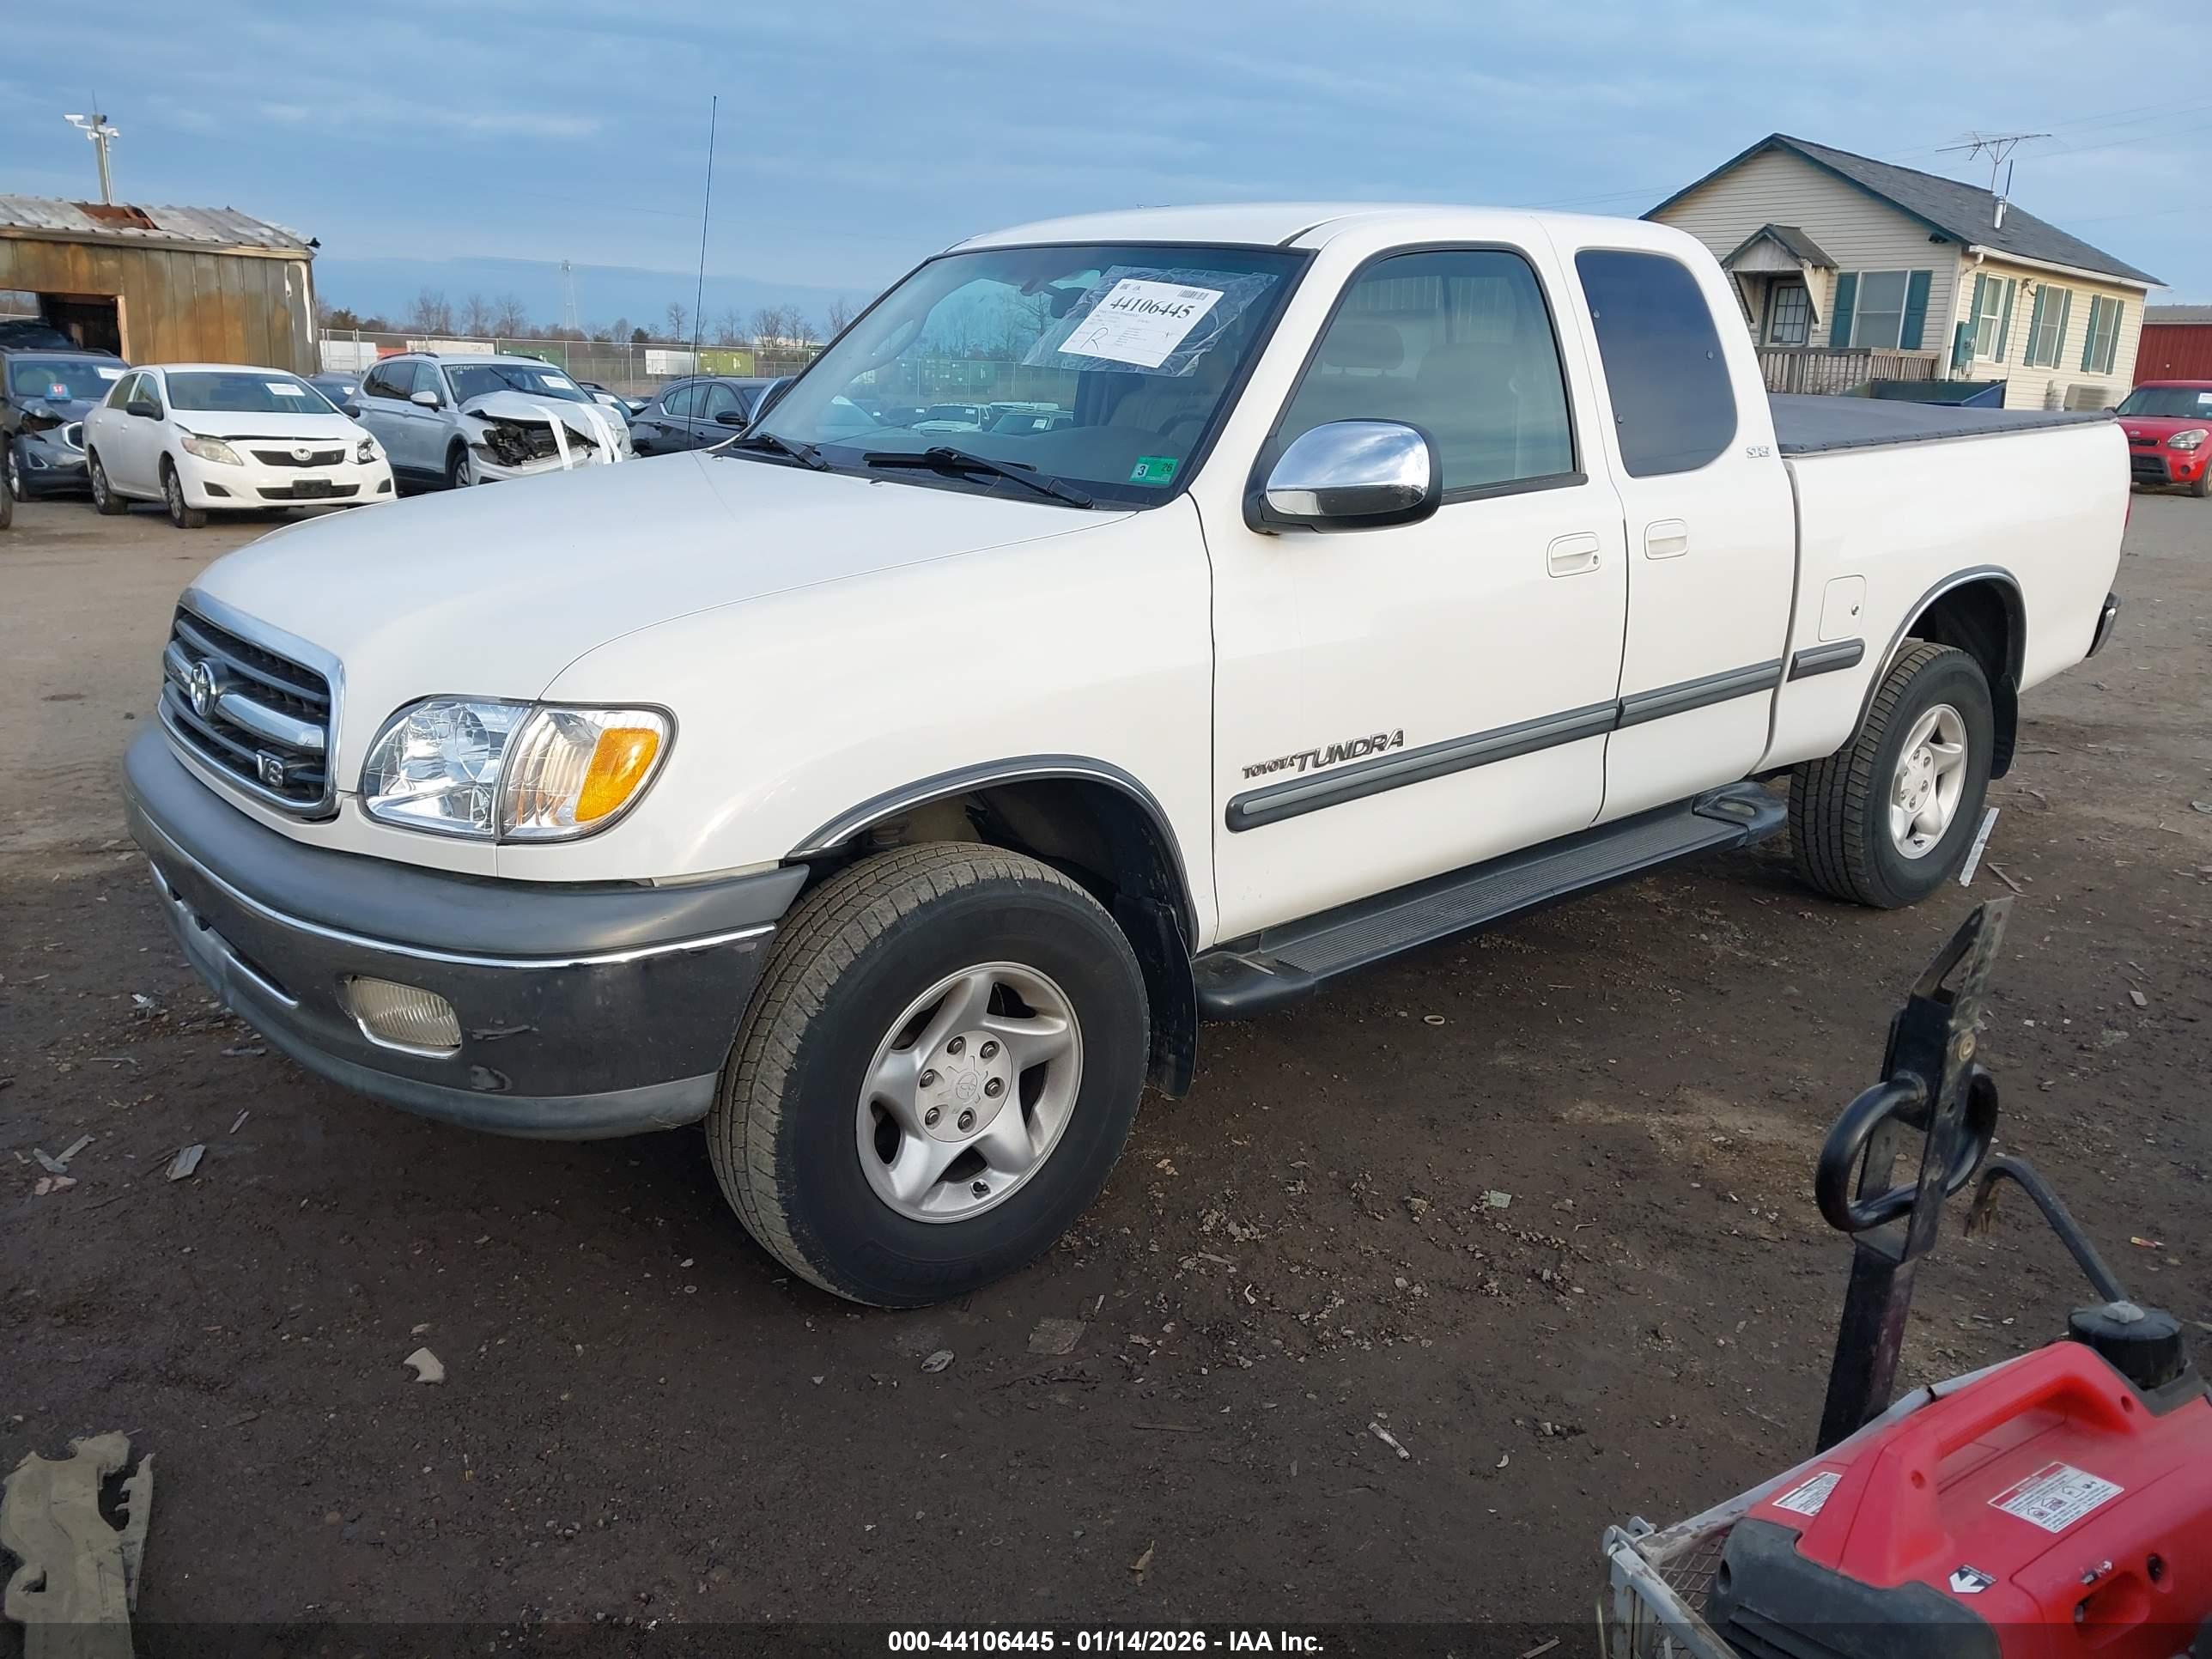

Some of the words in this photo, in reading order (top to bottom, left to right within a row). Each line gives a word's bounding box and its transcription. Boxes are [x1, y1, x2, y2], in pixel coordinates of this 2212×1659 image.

[1109, 296, 1196, 319] 44106445
[1137, 465, 1146, 477] 3
[1161, 463, 1173, 472] 26
[1242, 755, 1297, 780] TOYOTA
[1295, 728, 1404, 772] TUNDRA
[256, 753, 283, 787] V8
